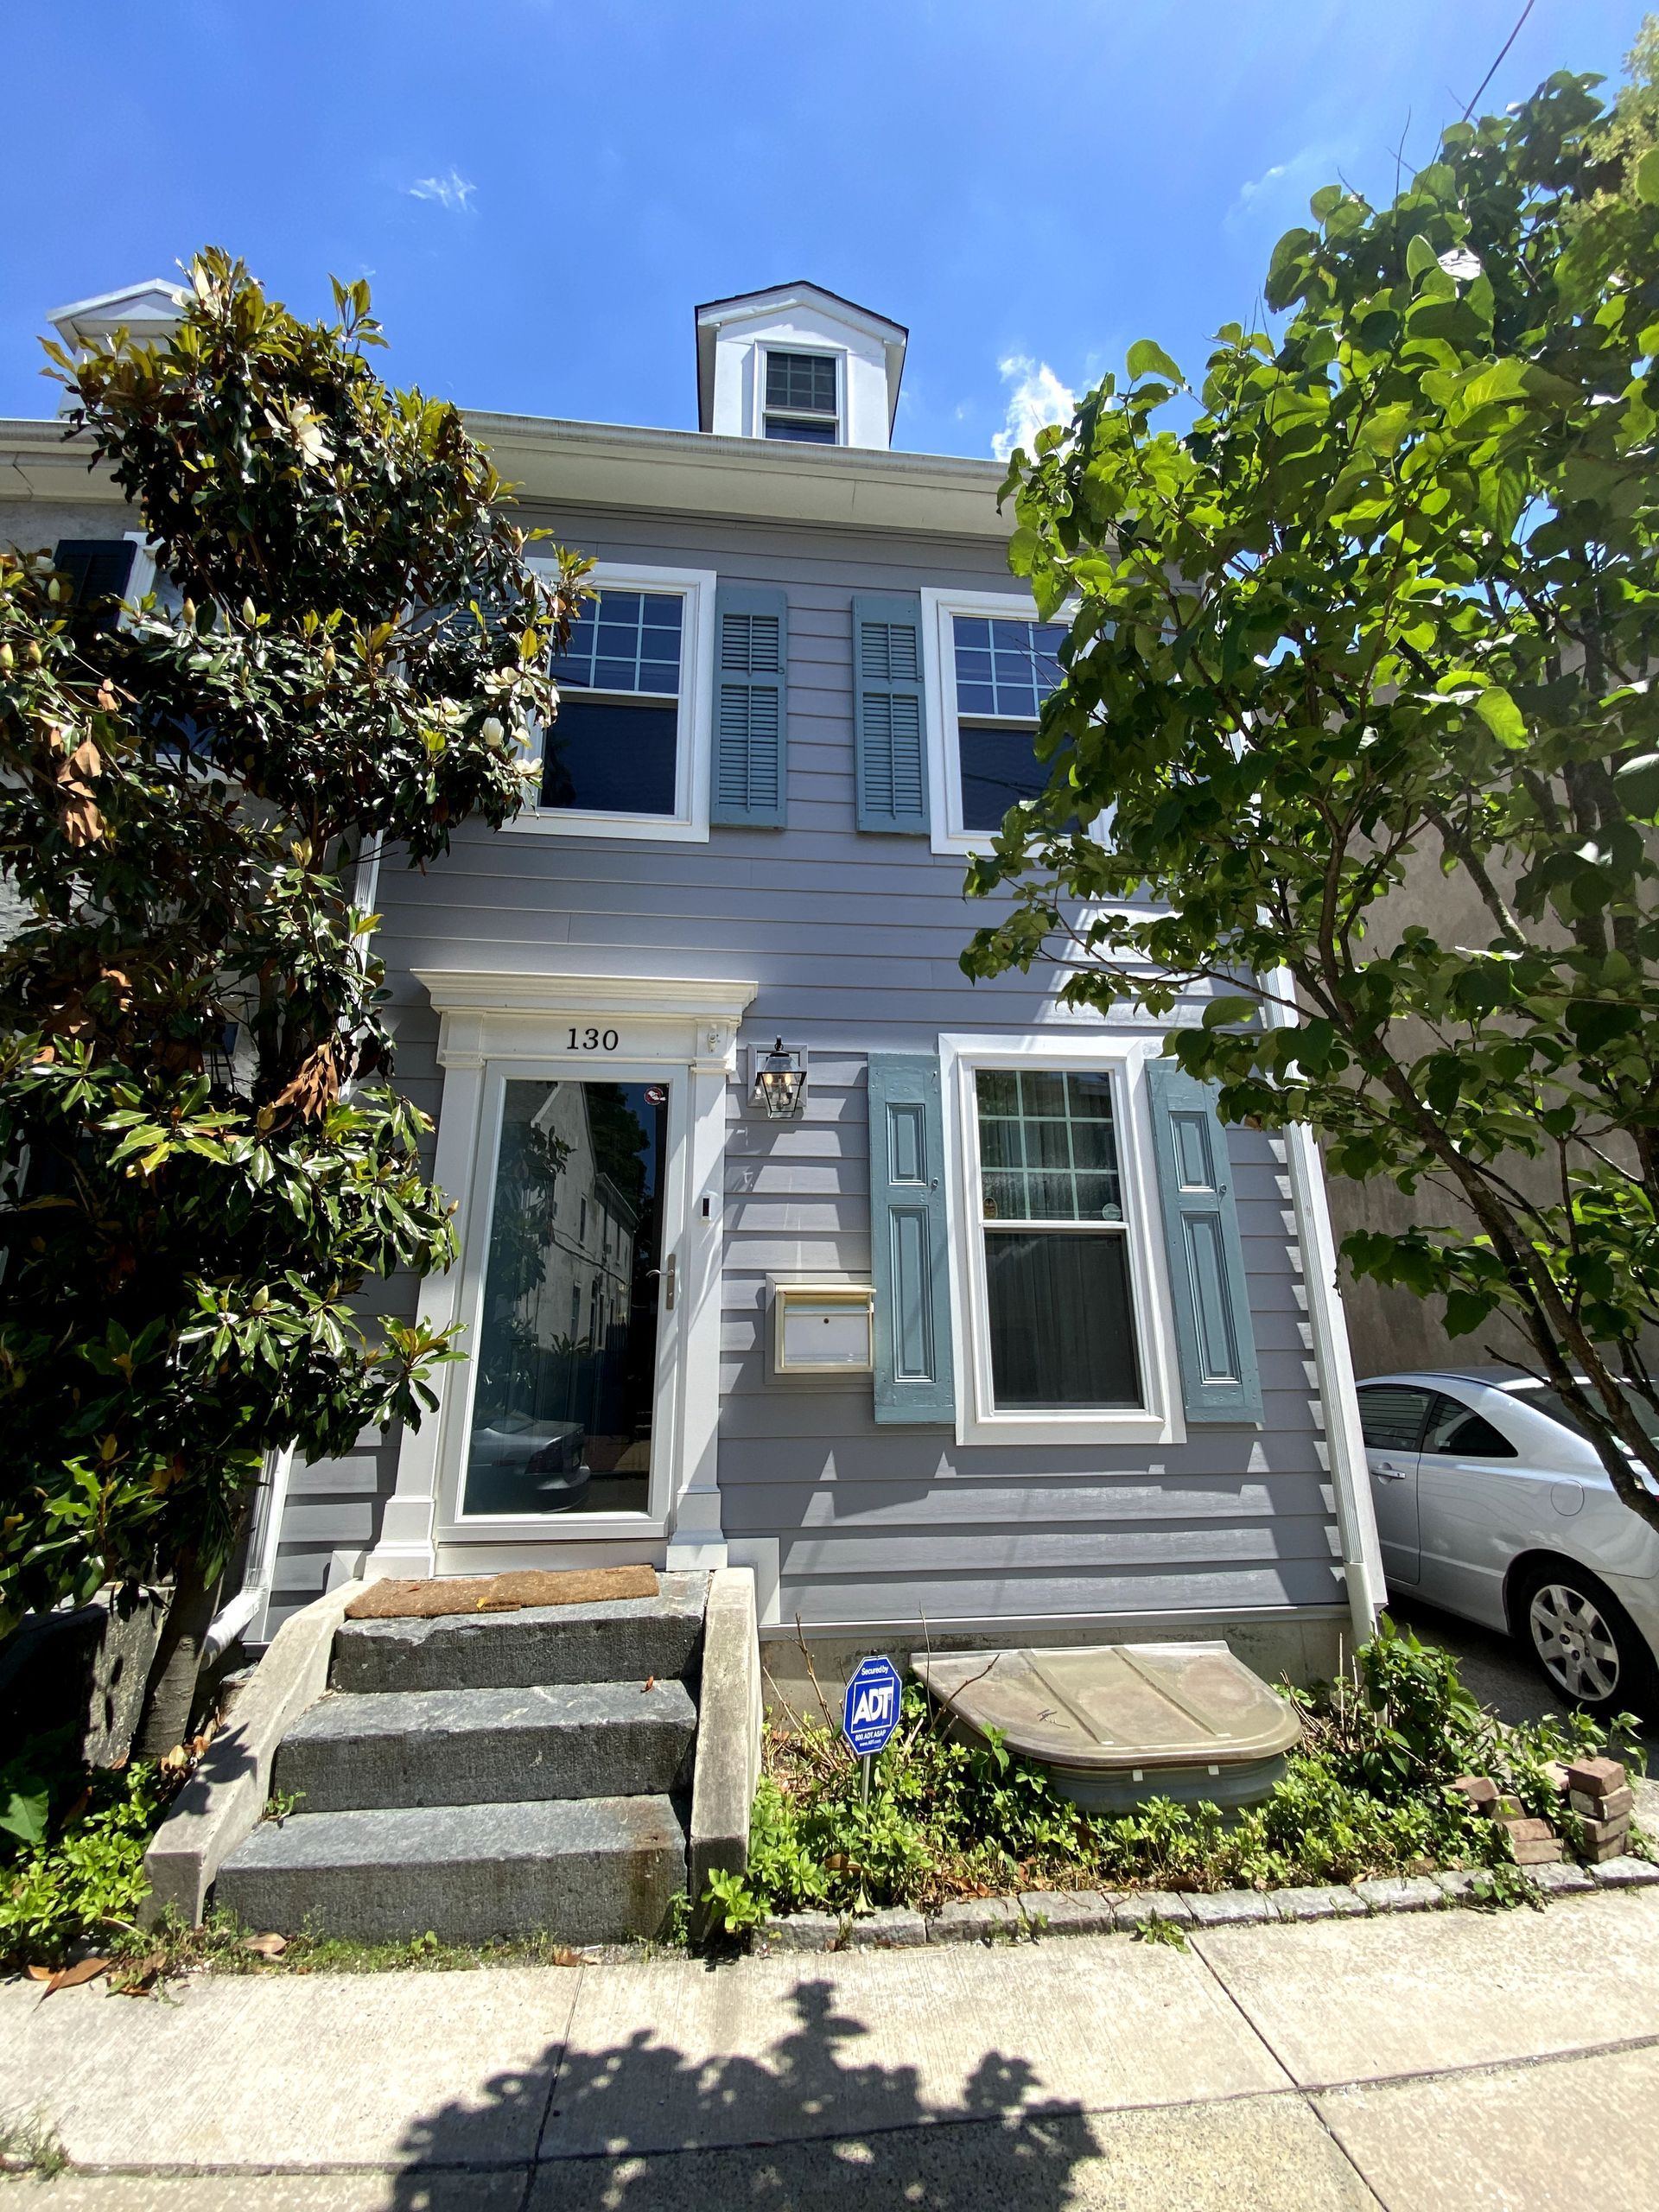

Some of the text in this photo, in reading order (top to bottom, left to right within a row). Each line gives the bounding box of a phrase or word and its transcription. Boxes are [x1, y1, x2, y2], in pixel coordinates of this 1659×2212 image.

[567, 1027, 619, 1051] 130
[861, 1665, 888, 1675] Secured by
[853, 1687, 893, 1725] ADT
